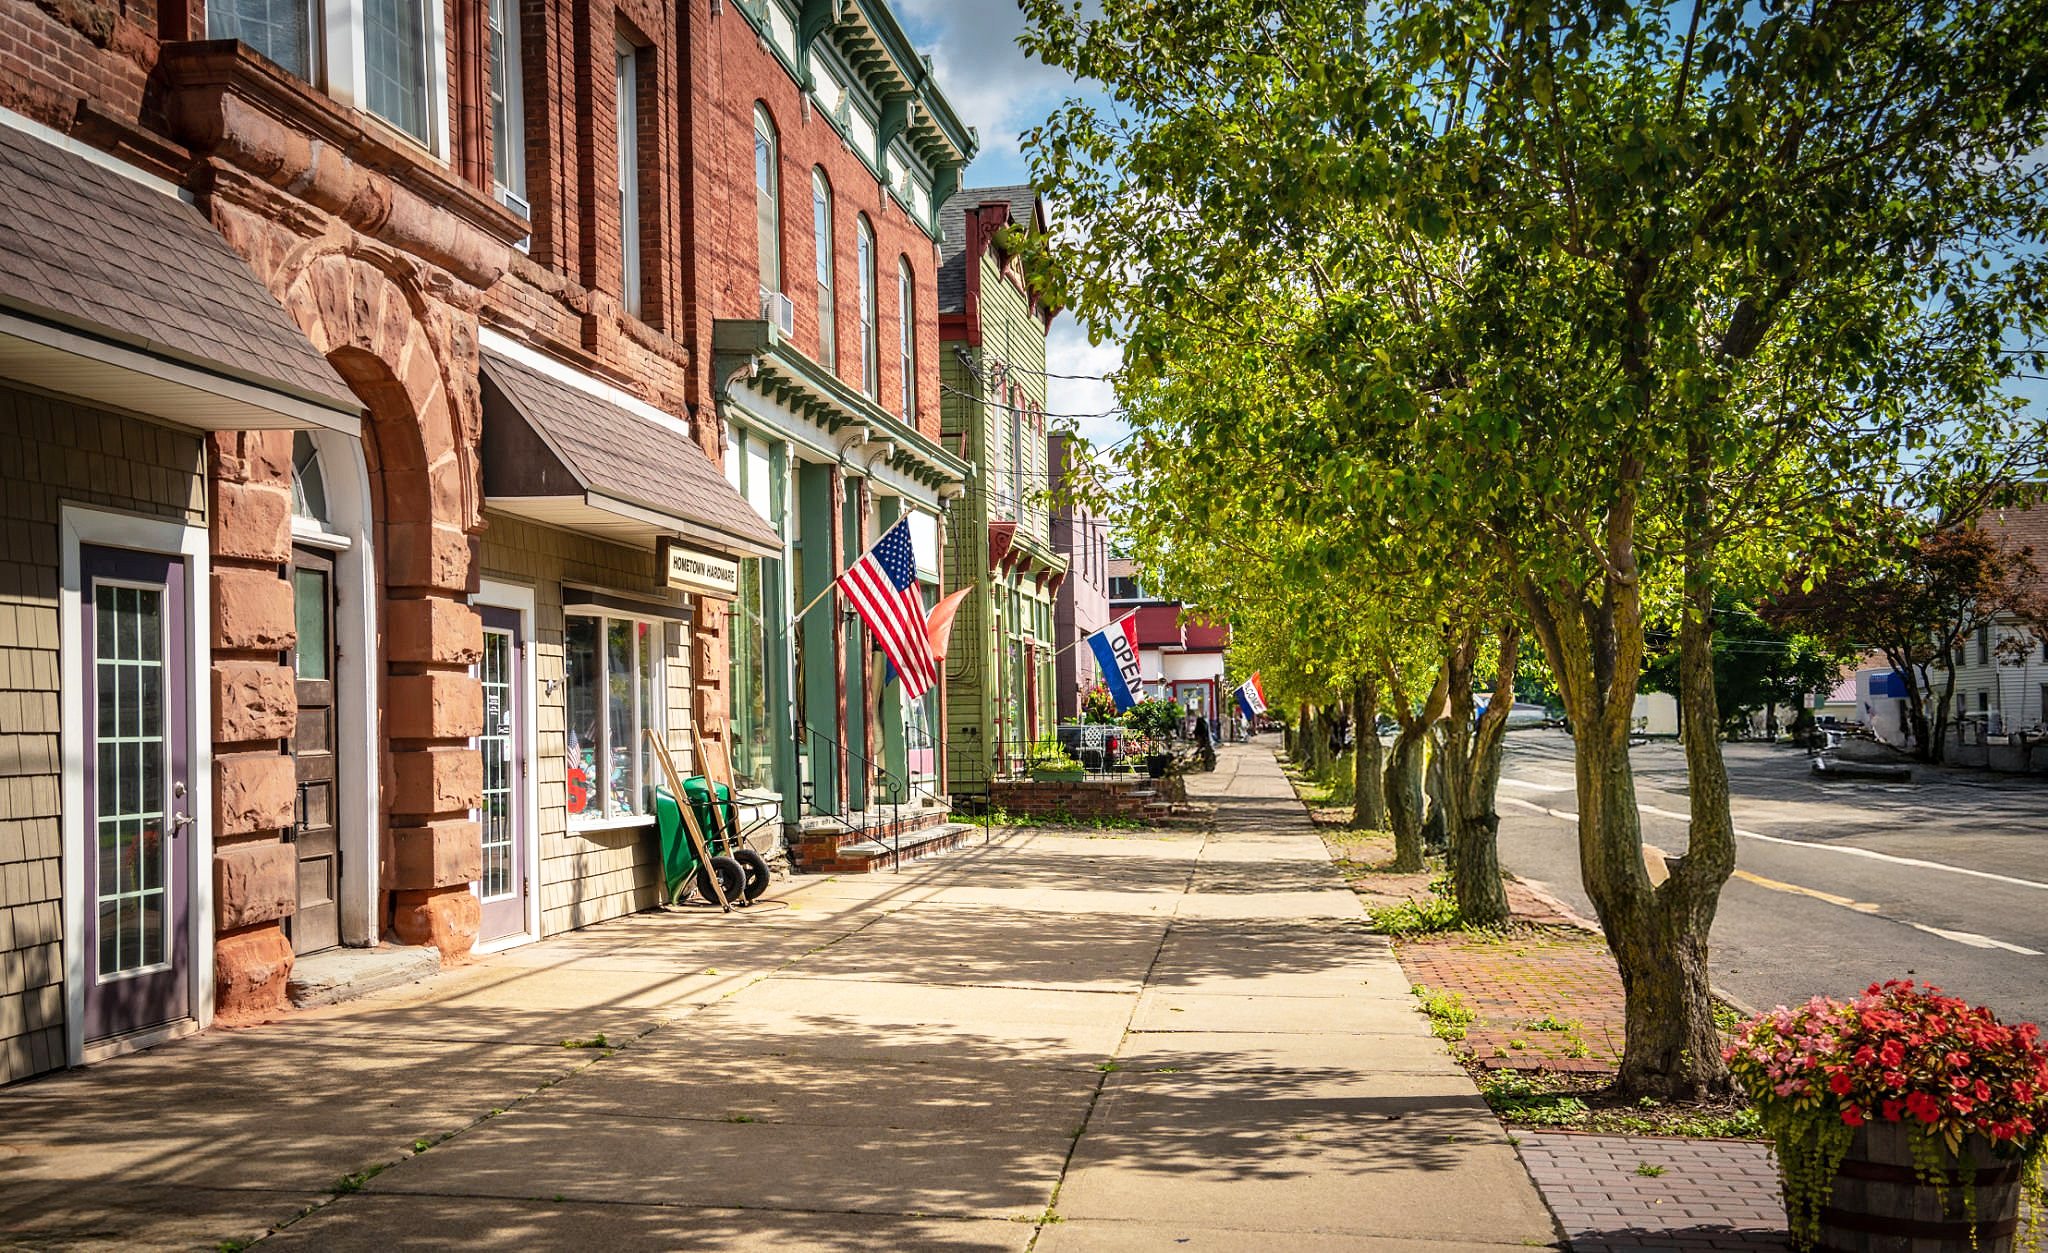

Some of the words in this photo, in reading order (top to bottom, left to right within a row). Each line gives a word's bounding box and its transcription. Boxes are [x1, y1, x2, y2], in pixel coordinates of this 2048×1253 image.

[673, 555, 706, 576] HOMETOWN
[706, 564, 735, 583] HARDWARE
[1111, 635, 1142, 694] OPEN
